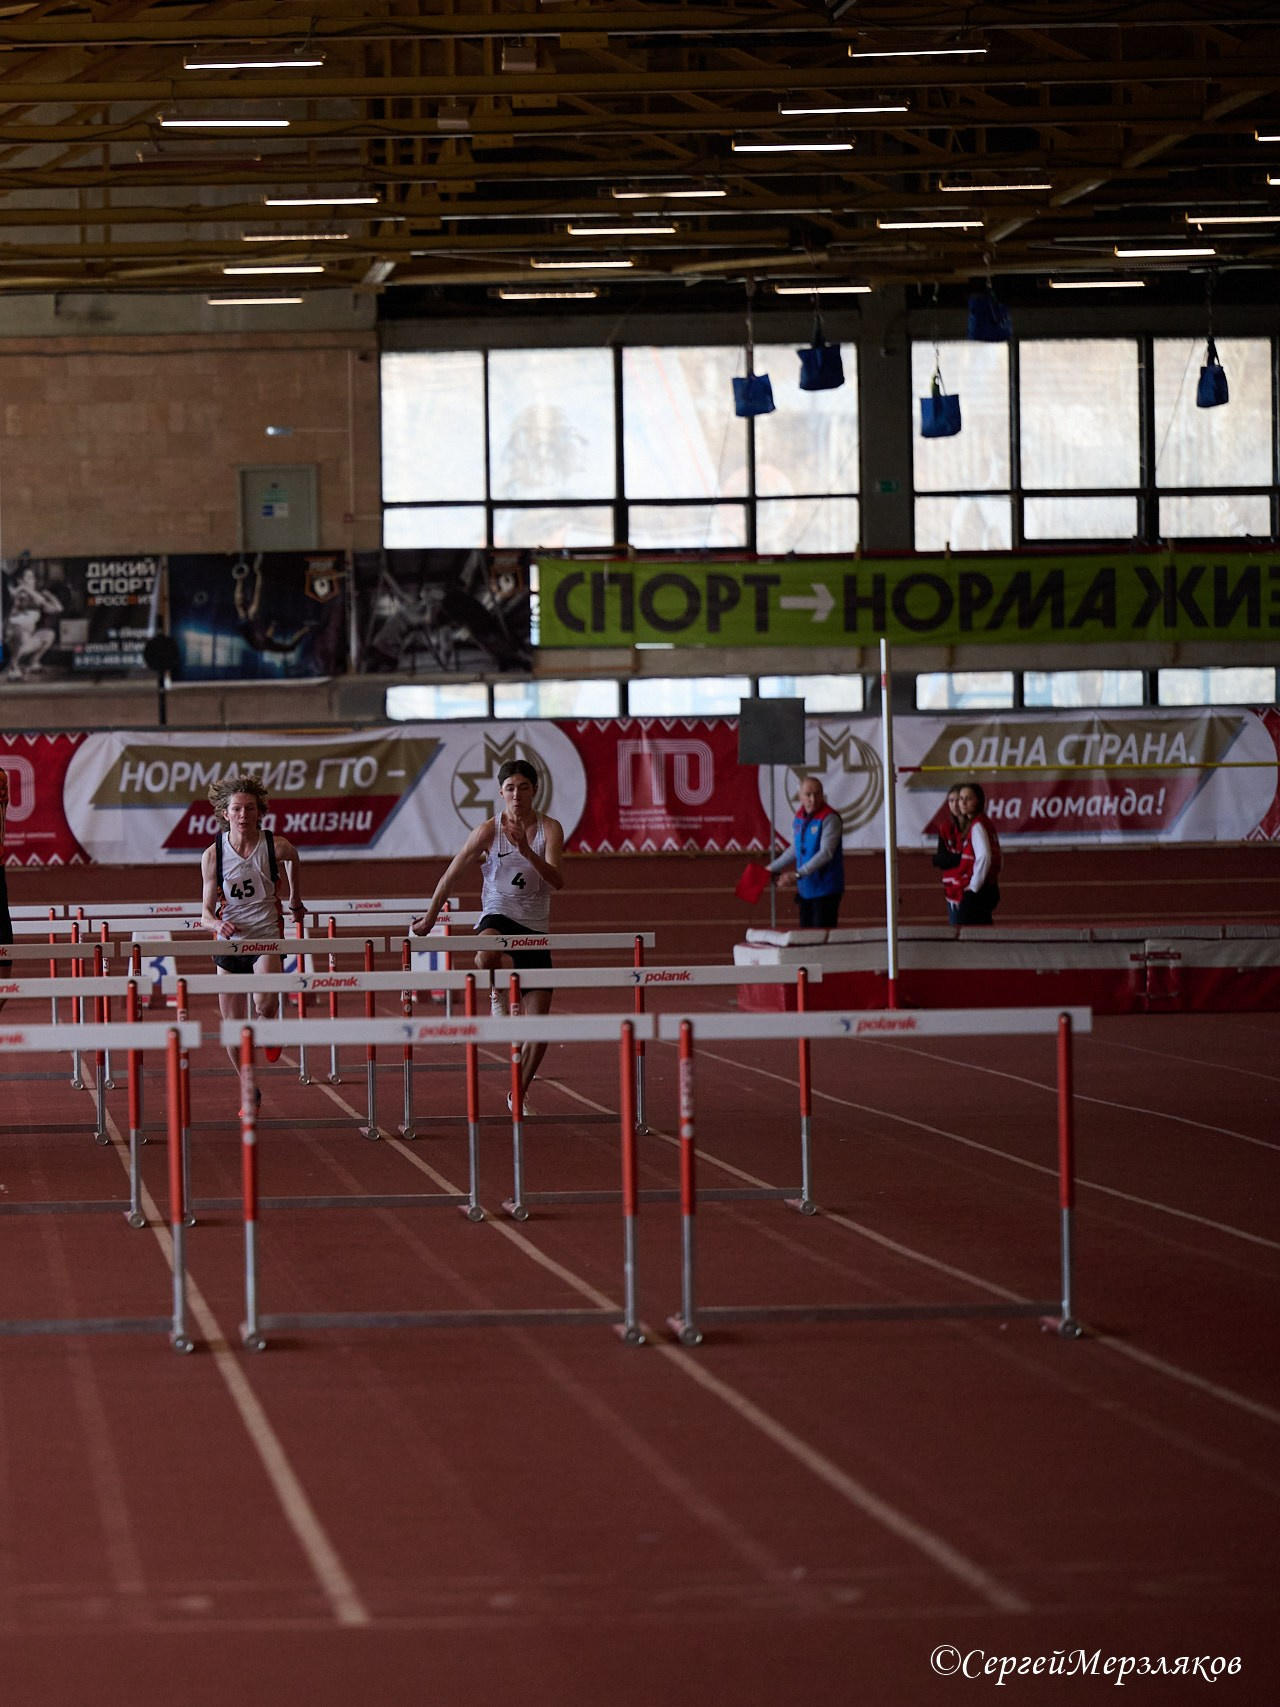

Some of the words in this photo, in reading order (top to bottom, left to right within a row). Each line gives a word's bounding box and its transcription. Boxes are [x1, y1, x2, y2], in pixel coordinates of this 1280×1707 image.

[86, 557, 157, 578] ДИКИЙ
[86, 578, 155, 595] СПОРТ
[553, 571, 781, 634] СПОРТ
[843, 567, 1117, 633] НОРМА
[949, 735, 1048, 768] ОДНА
[315, 755, 379, 790] ГТО
[1030, 787, 1166, 818] команда!
[283, 810, 373, 833] жизни
[230, 879, 255, 900] 45
[511, 873, 527, 890] 4
[240, 941, 280, 954] polanik
[510, 936, 550, 949] polanik
[311, 976, 359, 990] polanik
[644, 969, 691, 984] polanik
[856, 1015, 917, 1033] polanik
